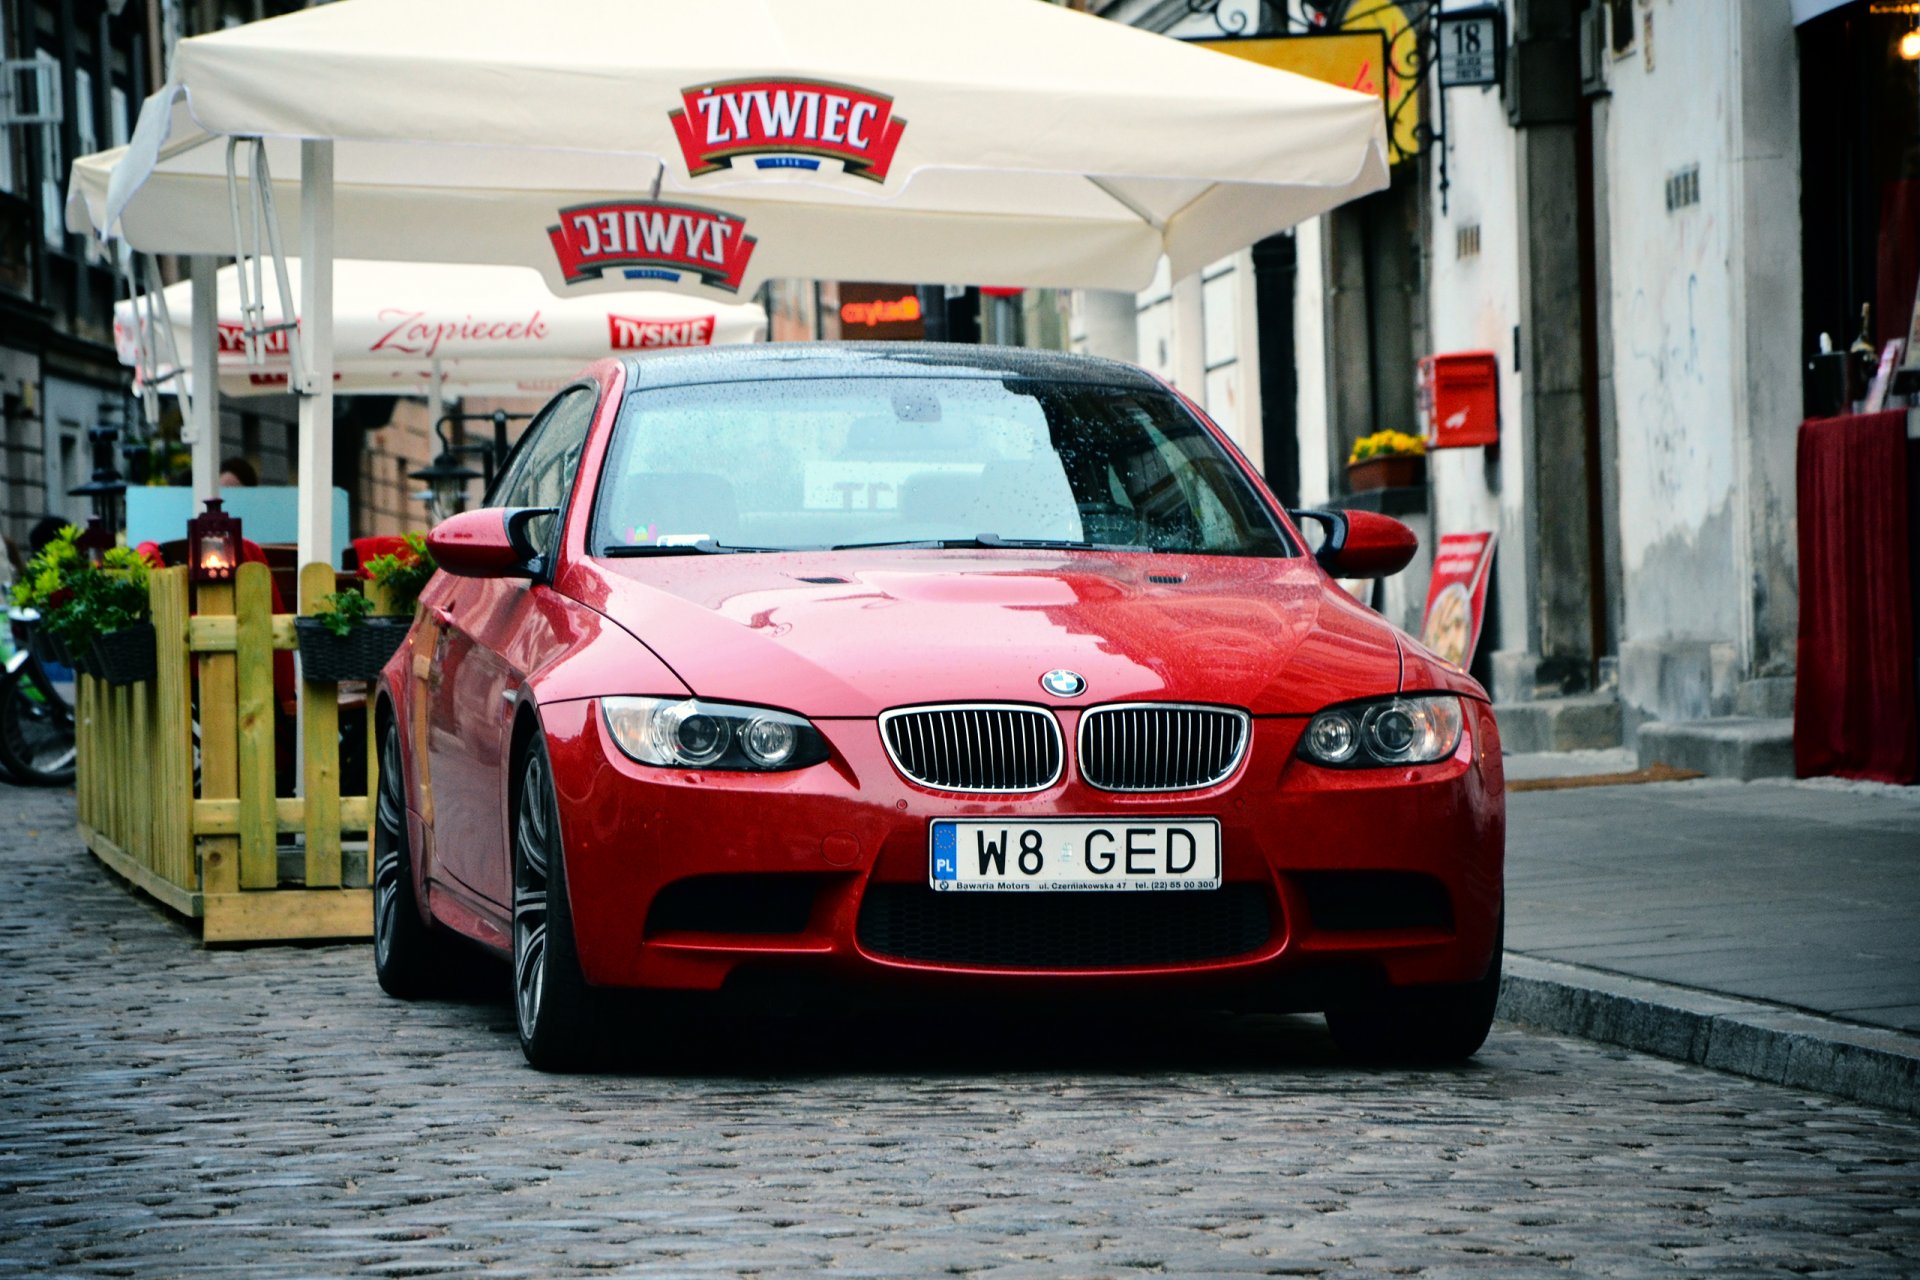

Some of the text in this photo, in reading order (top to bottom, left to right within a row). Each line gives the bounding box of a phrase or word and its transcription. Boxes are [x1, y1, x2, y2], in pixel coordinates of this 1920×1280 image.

[1452, 24, 1481, 54] 18
[697, 88, 877, 150] ŻYWIEC
[369, 308, 549, 357] Zapiecek
[614, 319, 709, 347] TYSKIE
[937, 859, 953, 872] PL
[977, 828, 1196, 876] W8 GED
[956, 882, 994, 890] Bawaria
[997, 882, 1030, 890] Motors
[1038, 882, 1049, 890] ul.
[1116, 881, 1127, 890] 47
[1135, 881, 1149, 889] tel.
[1151, 881, 1168, 891] (22)
[1184, 881, 1195, 889] 00
[1197, 881, 1214, 889] 300
